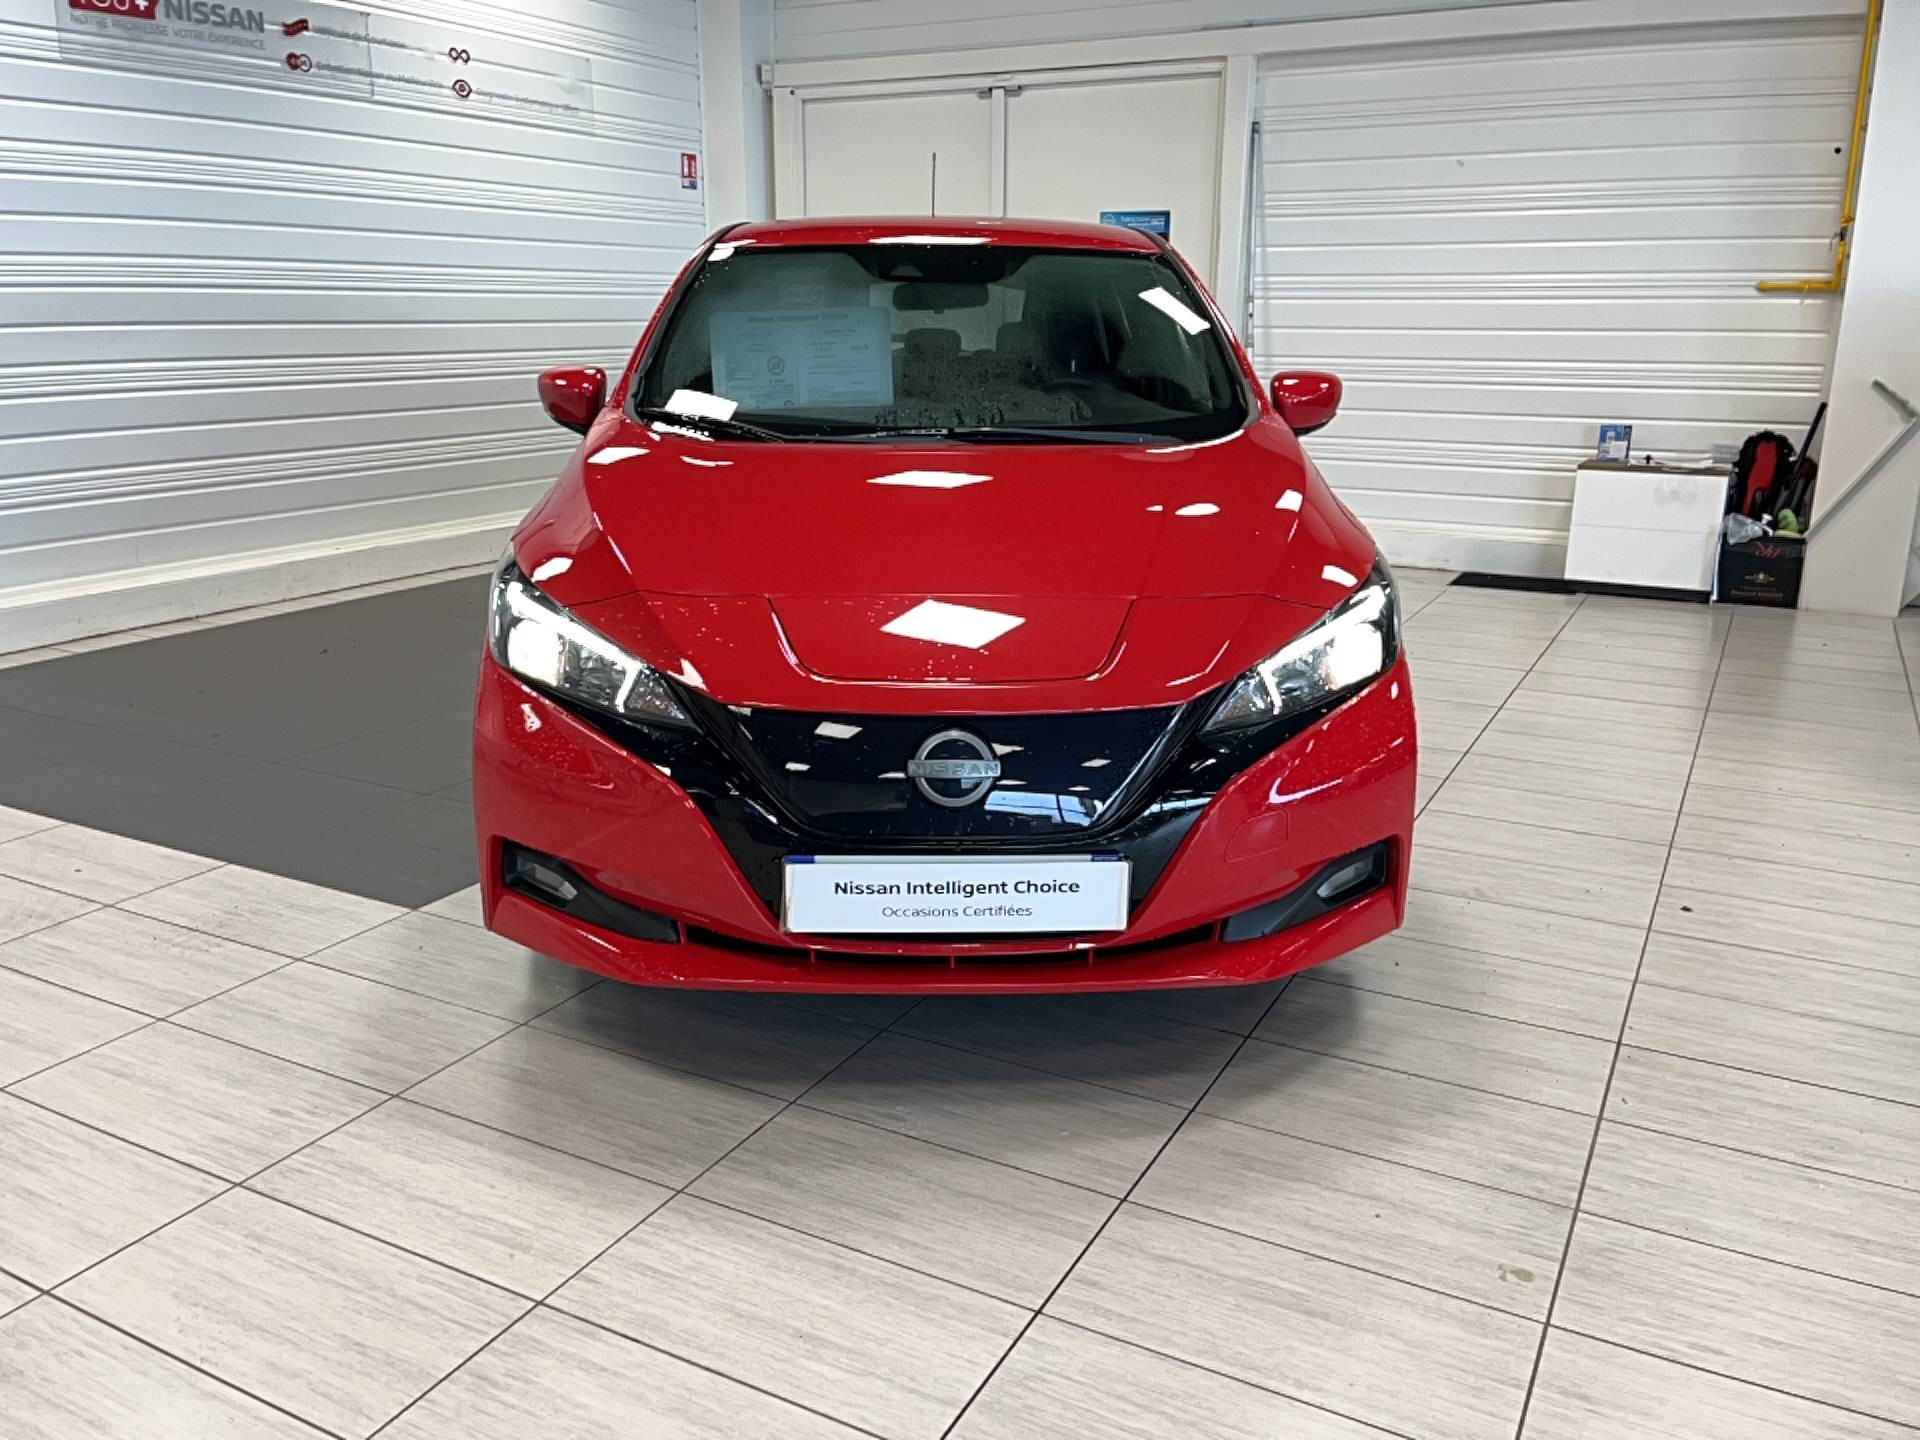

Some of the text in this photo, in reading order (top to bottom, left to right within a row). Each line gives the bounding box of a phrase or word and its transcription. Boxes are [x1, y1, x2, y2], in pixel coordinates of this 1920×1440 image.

[70, 13, 109, 29] NOTRE
[165, 0, 265, 33] NISSAN
[909, 761, 999, 777] NISSAN
[834, 879, 1080, 898] Nissan Intelligent Choice
[882, 904, 1033, 918] Occasions Certifiées
